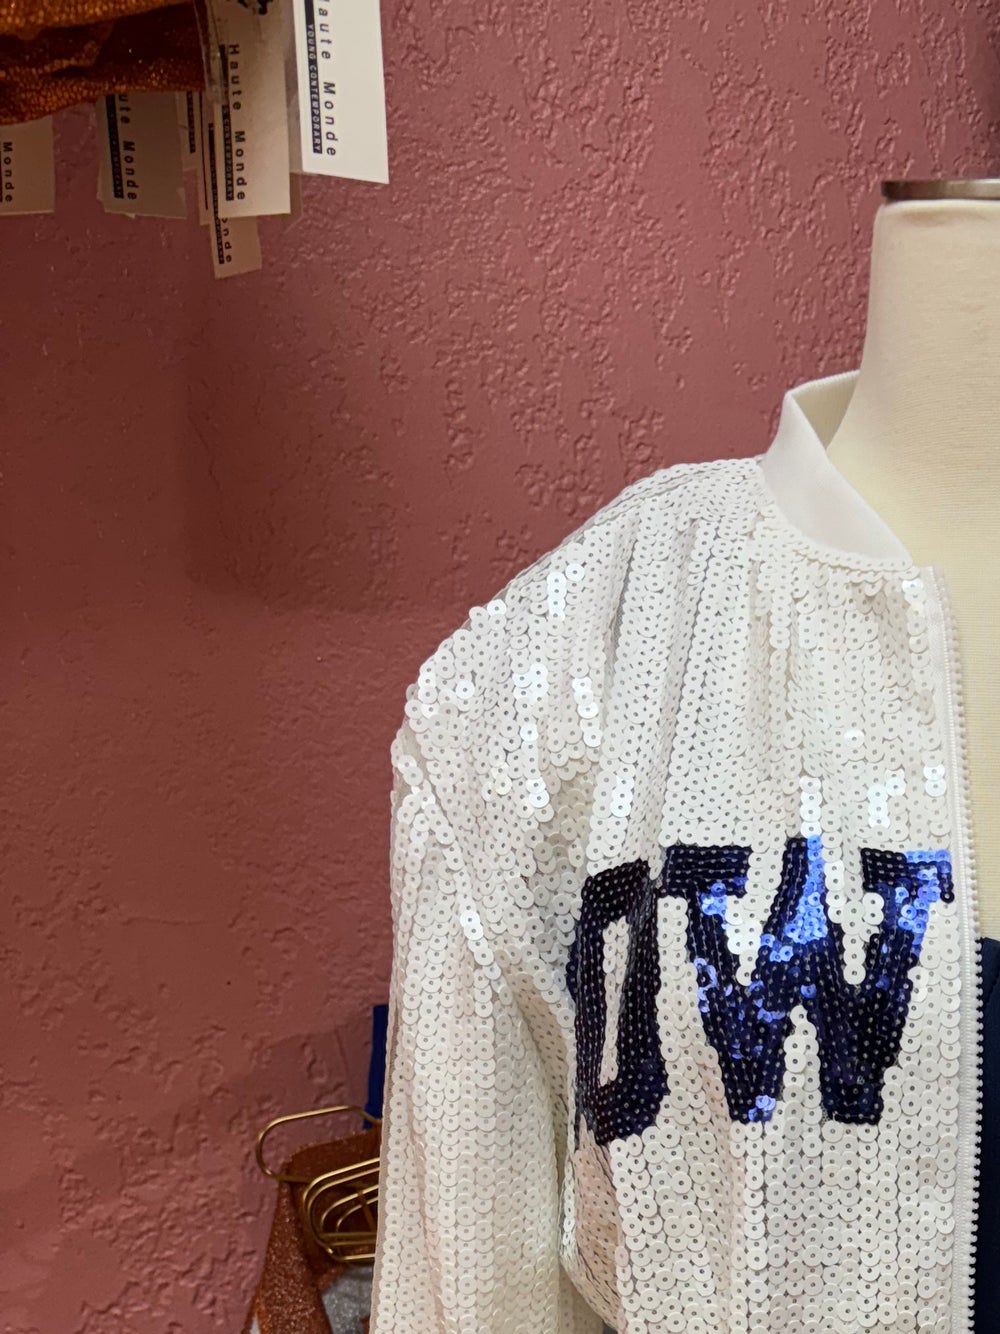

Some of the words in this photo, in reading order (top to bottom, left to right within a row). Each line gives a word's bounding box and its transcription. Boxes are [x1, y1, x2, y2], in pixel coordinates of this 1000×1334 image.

[307, 24, 316, 60] YOUNG
[118, 93, 131, 125] ute
[229, 44, 242, 111] Haute
[309, 64, 321, 152] CONTEMPORARY
[323, 82, 338, 156] Monde
[3, 141, 14, 203] Monde
[123, 141, 137, 200] Monde
[234, 131, 246, 200] Monde
[567, 835, 955, 1148] OW
